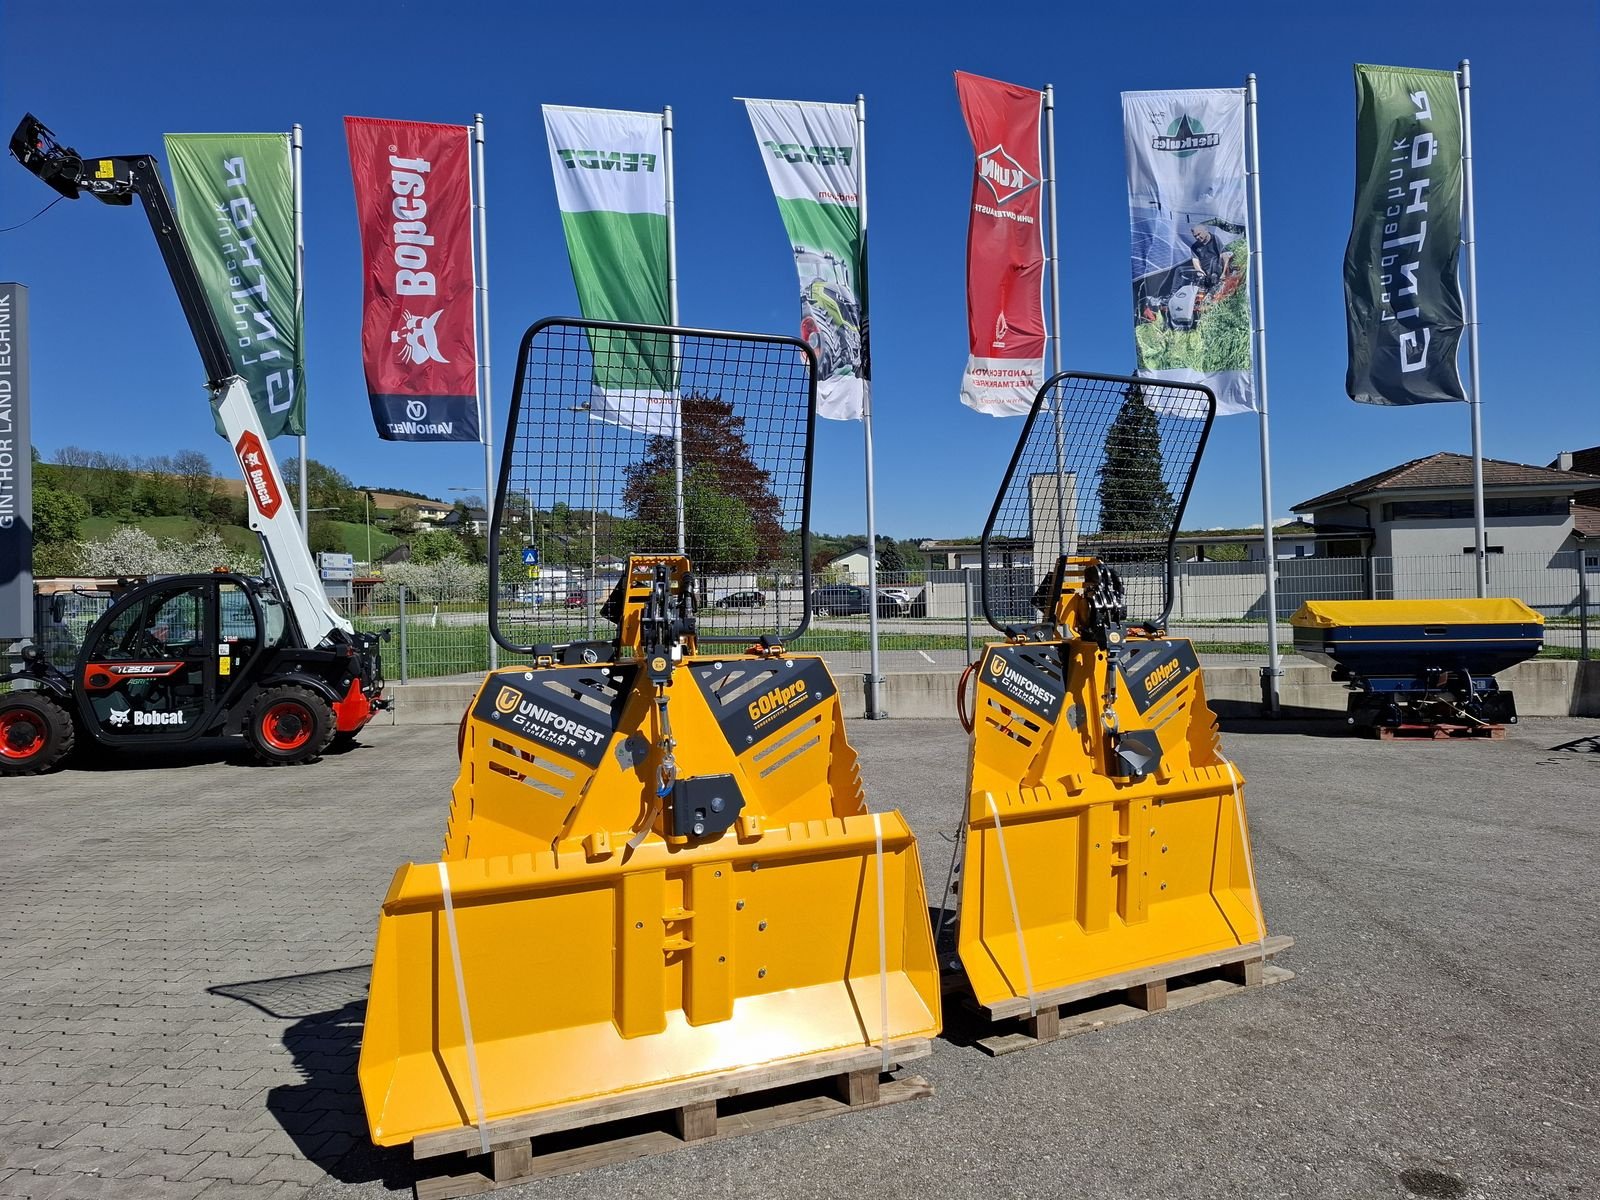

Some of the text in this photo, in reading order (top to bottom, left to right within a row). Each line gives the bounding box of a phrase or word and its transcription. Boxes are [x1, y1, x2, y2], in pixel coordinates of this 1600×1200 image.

[250, 469, 273, 507] Bobcat
[1004, 666, 1056, 705] UNIFOREST
[1144, 658, 1179, 691] 60Hpro
[134, 710, 184, 725] Bobcat
[748, 679, 806, 720] 60Hpro
[519, 700, 605, 746] UNIFOREST
